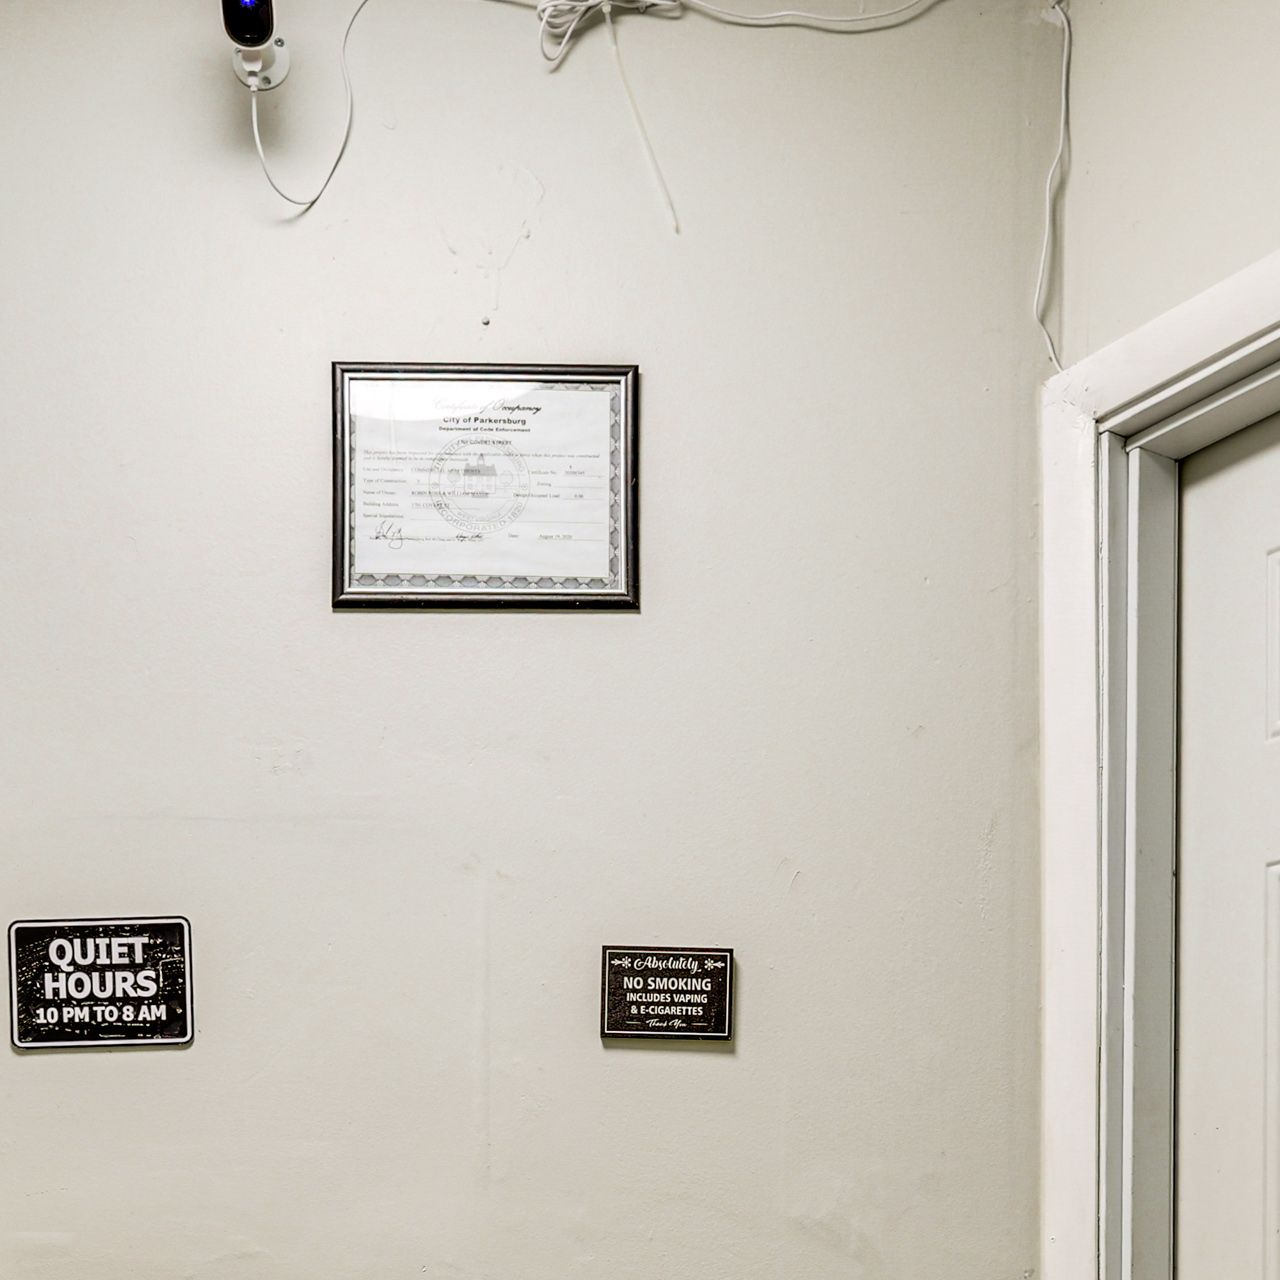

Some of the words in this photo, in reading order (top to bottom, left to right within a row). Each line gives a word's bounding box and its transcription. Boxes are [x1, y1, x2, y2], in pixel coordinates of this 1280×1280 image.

[443, 417, 460, 425] City
[473, 416, 527, 426] Parkersburg
[48, 936, 149, 972] QUIET
[633, 955, 702, 975] Absolutely
[44, 970, 158, 1000] HOURS
[623, 976, 644, 989] NO
[647, 977, 712, 991] SMOKING
[626, 992, 671, 1003] INCLUDES
[673, 993, 708, 1004] VAPING
[35, 1007, 59, 1024] 10
[62, 1006, 90, 1023] PM
[92, 1005, 119, 1022] TO
[122, 1005, 135, 1021] 8
[138, 1004, 167, 1021] AM
[630, 1005, 638, 1014] &
[640, 1005, 704, 1016] E-CIGARETTES
